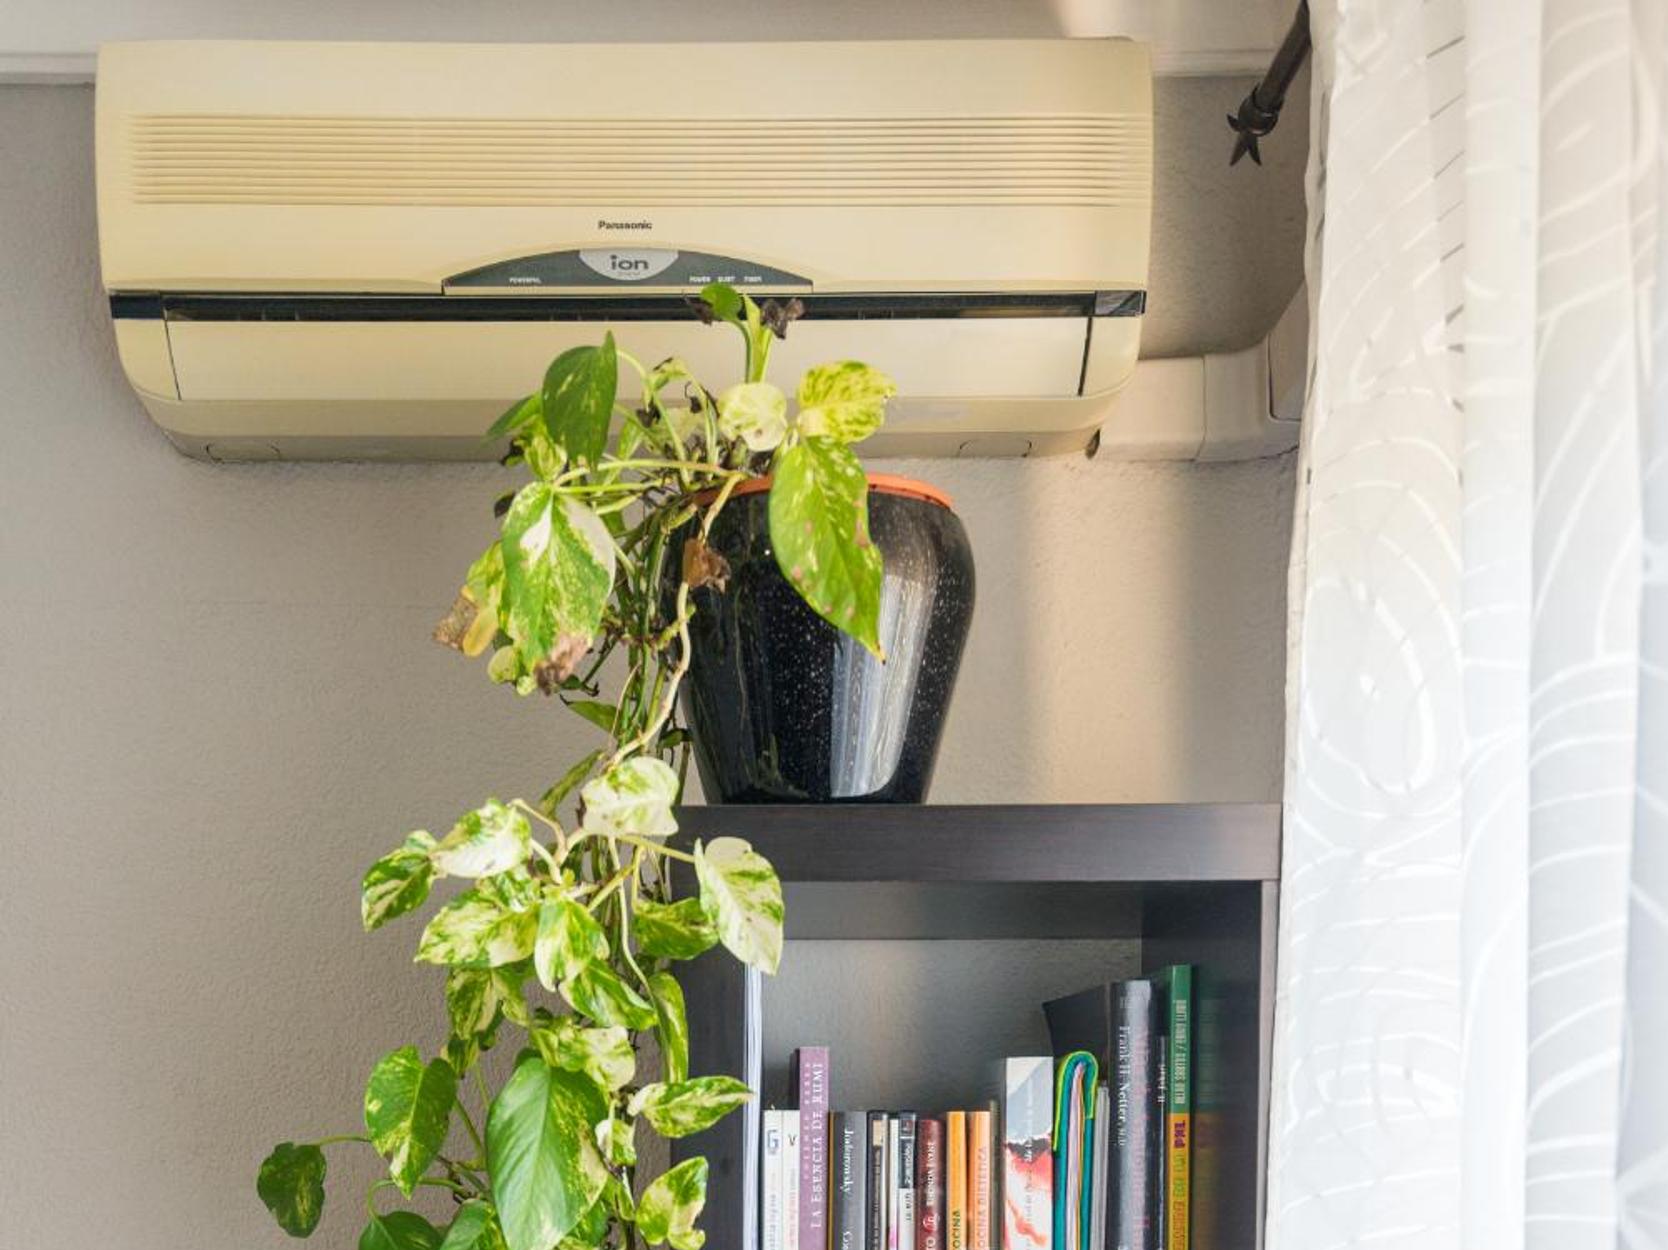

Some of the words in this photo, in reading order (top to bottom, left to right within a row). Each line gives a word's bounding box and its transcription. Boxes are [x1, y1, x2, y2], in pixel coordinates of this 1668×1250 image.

[598, 219, 653, 231] Panasonic
[610, 254, 649, 272] ion
[1119, 1025, 1132, 1062] Frank
[810, 1063, 823, 1106] RUMI
[810, 1110, 823, 1131] DE
[1173, 1119, 1187, 1149] PNL
[810, 1136, 823, 1203] ESENCIA
[840, 1128, 856, 1194] Jodorowsky
[810, 1209, 823, 1229] LA
